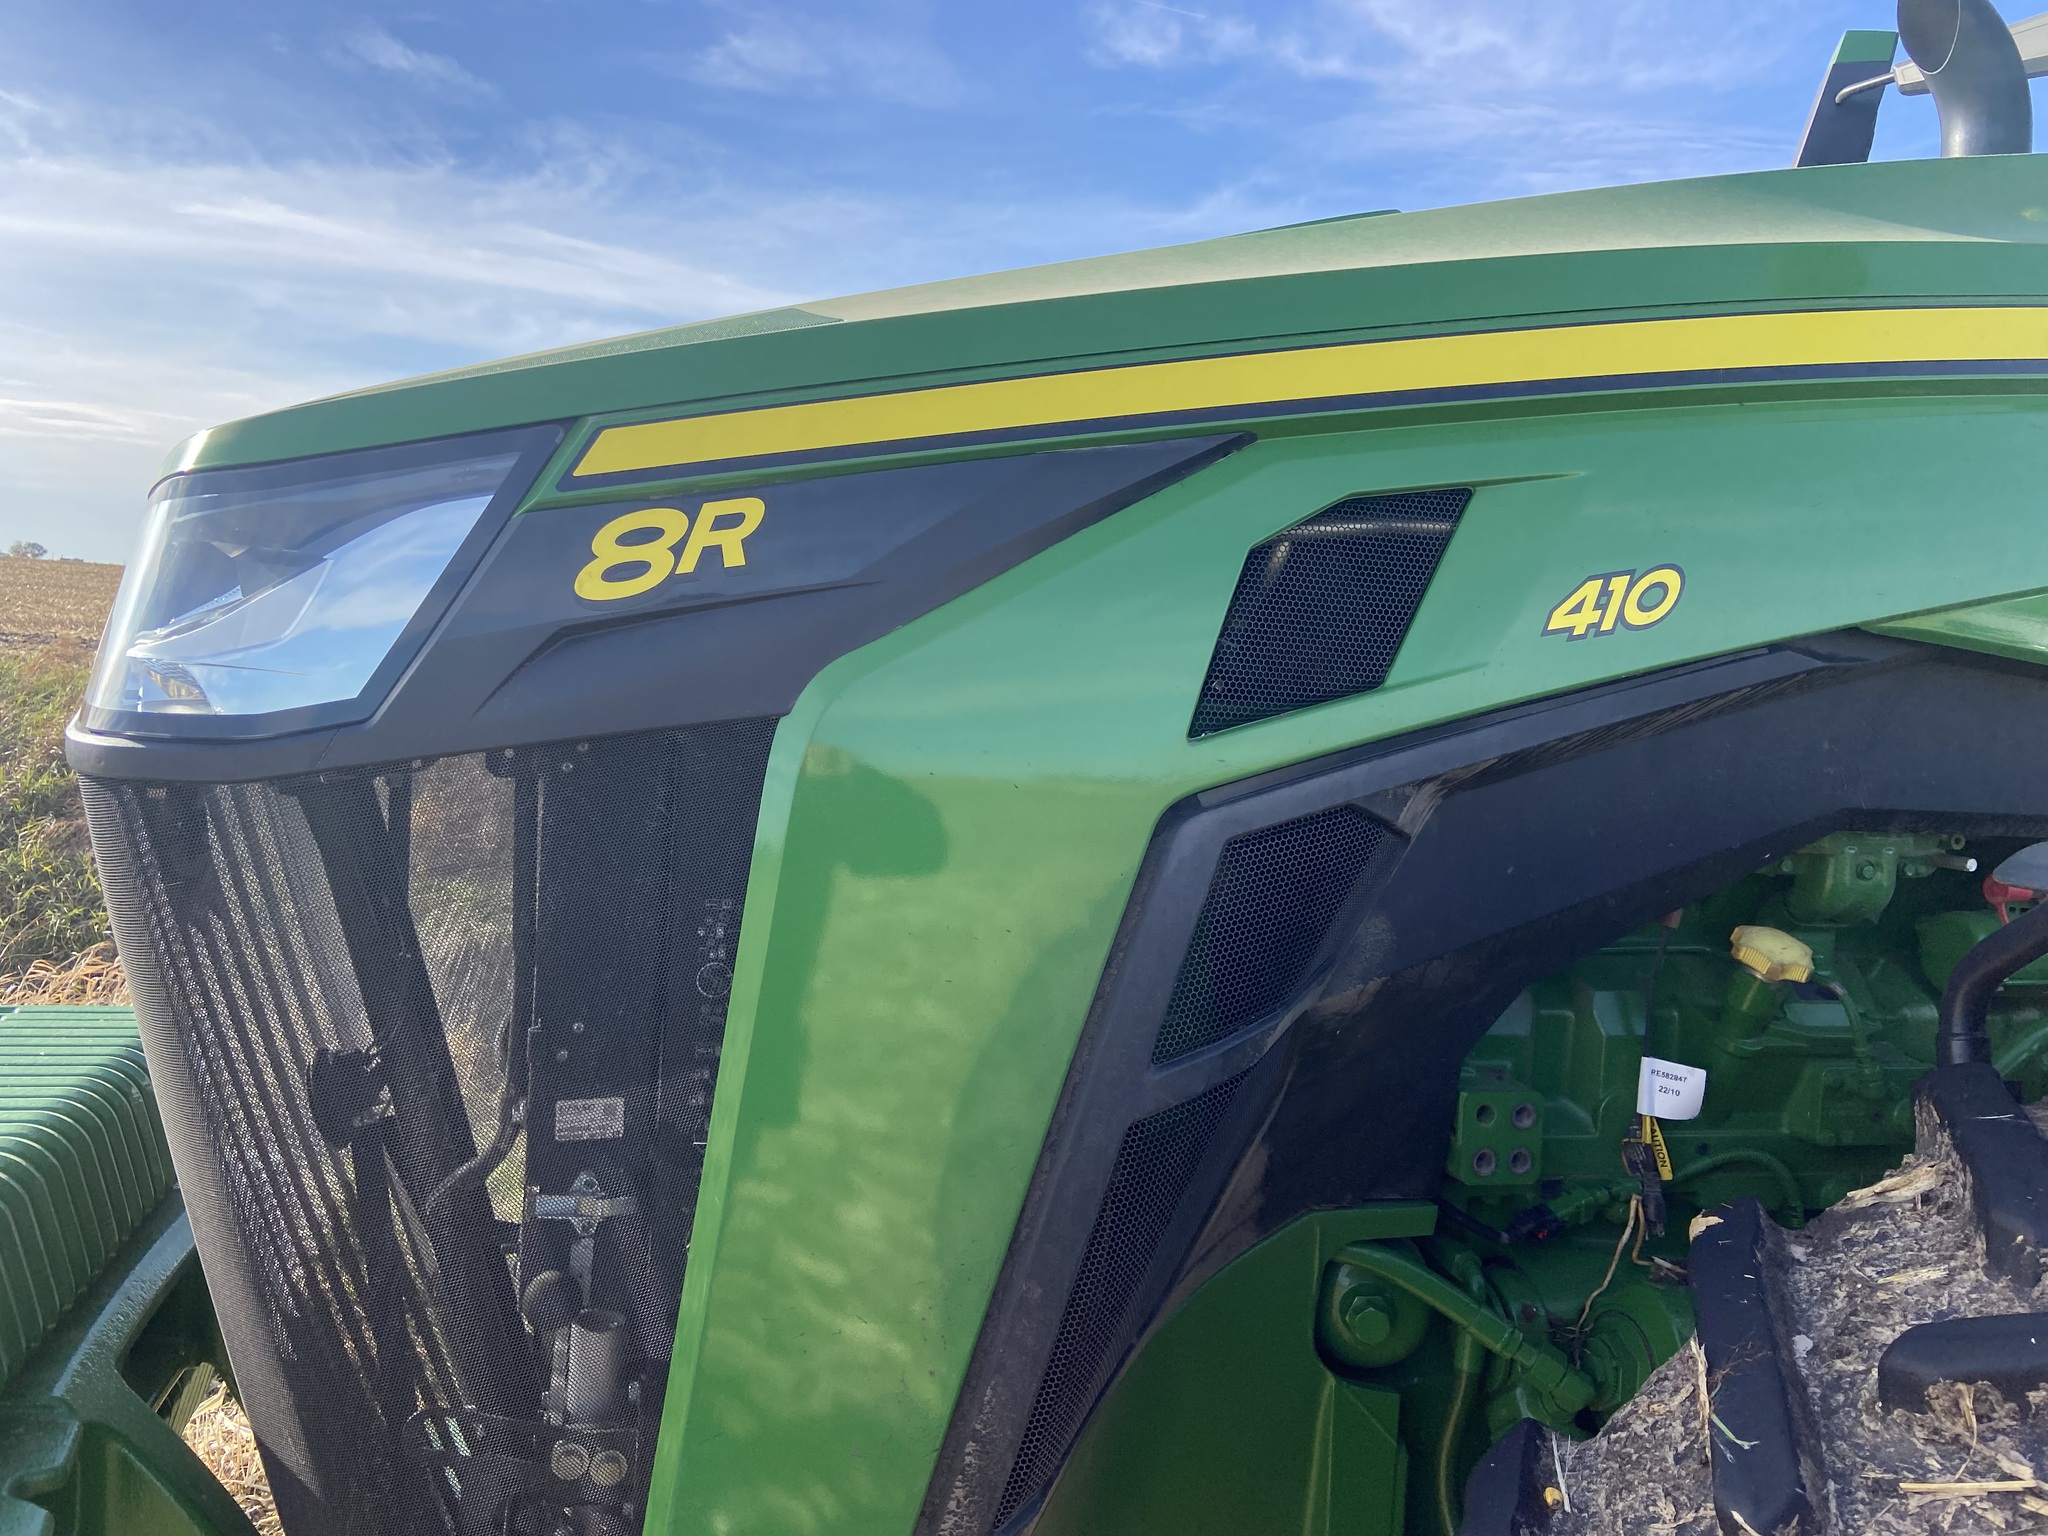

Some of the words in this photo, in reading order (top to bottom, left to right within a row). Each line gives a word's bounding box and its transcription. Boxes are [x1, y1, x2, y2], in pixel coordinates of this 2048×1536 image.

[573, 496, 767, 602] 8R
[1545, 567, 1683, 638] 410
[1658, 1085, 1681, 1097] 22/10
